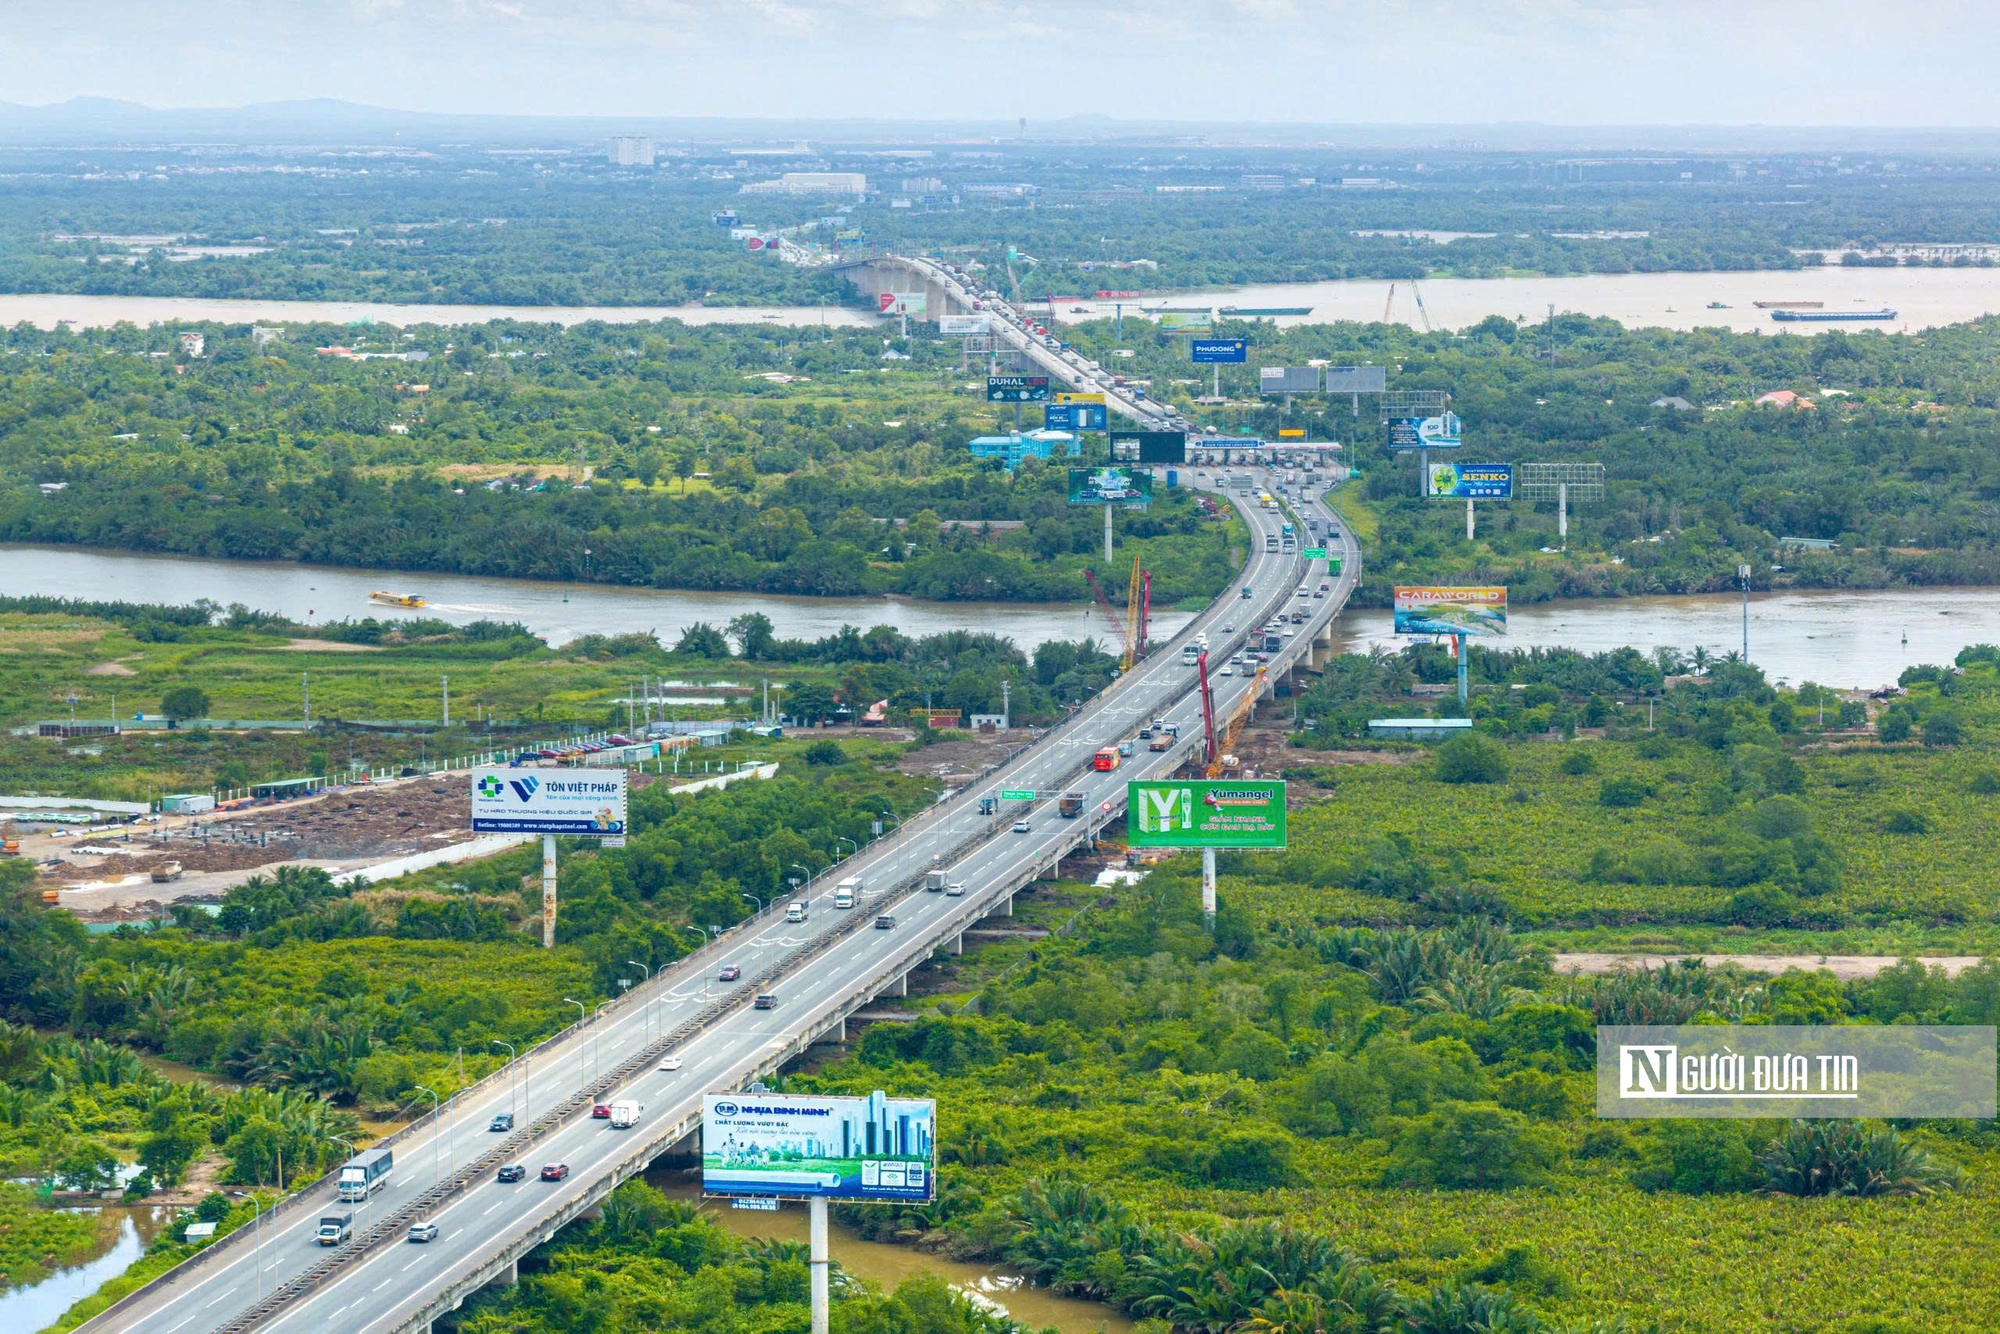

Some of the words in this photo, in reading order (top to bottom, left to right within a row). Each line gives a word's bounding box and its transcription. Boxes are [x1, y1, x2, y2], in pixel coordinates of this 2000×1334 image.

[989, 378, 1024, 386] DUHAL
[1462, 473, 1509, 481] SENKO
[1399, 591, 1499, 600] CARAWORLD
[546, 781, 565, 792] TÔN
[567, 781, 588, 794] VIỆT
[591, 782, 618, 793] PHÁP
[1211, 789, 1274, 800] Yumangel
[523, 823, 588, 831] www.vietphapsteel.com
